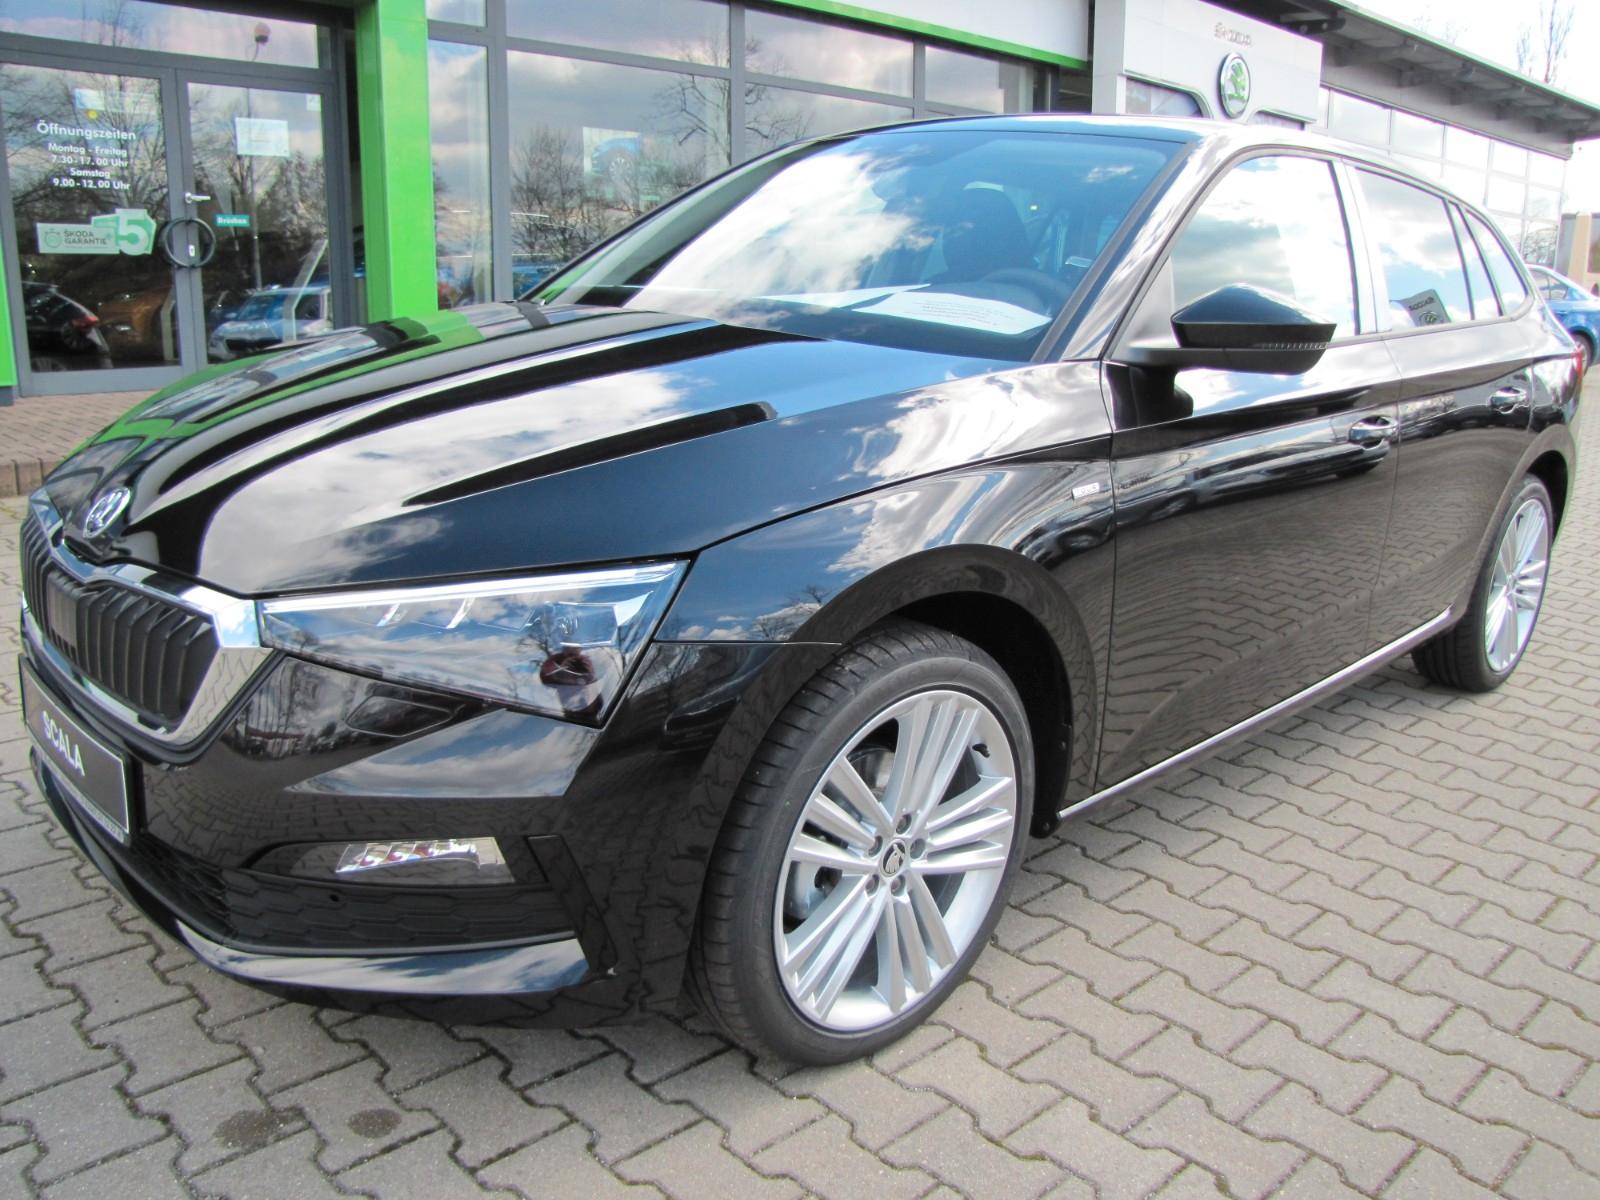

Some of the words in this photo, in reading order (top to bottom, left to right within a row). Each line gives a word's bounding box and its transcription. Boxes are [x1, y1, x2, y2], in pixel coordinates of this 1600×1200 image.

[36, 119, 136, 140] Öffnungszeiten
[48, 142, 85, 155] Montag
[95, 146, 128, 158] Freitag
[111, 158, 129, 168] Uhr
[70, 167, 111, 179] Samstag
[112, 180, 131, 190] Uhr
[116, 208, 149, 256] 5
[42, 710, 85, 777] SCALA
